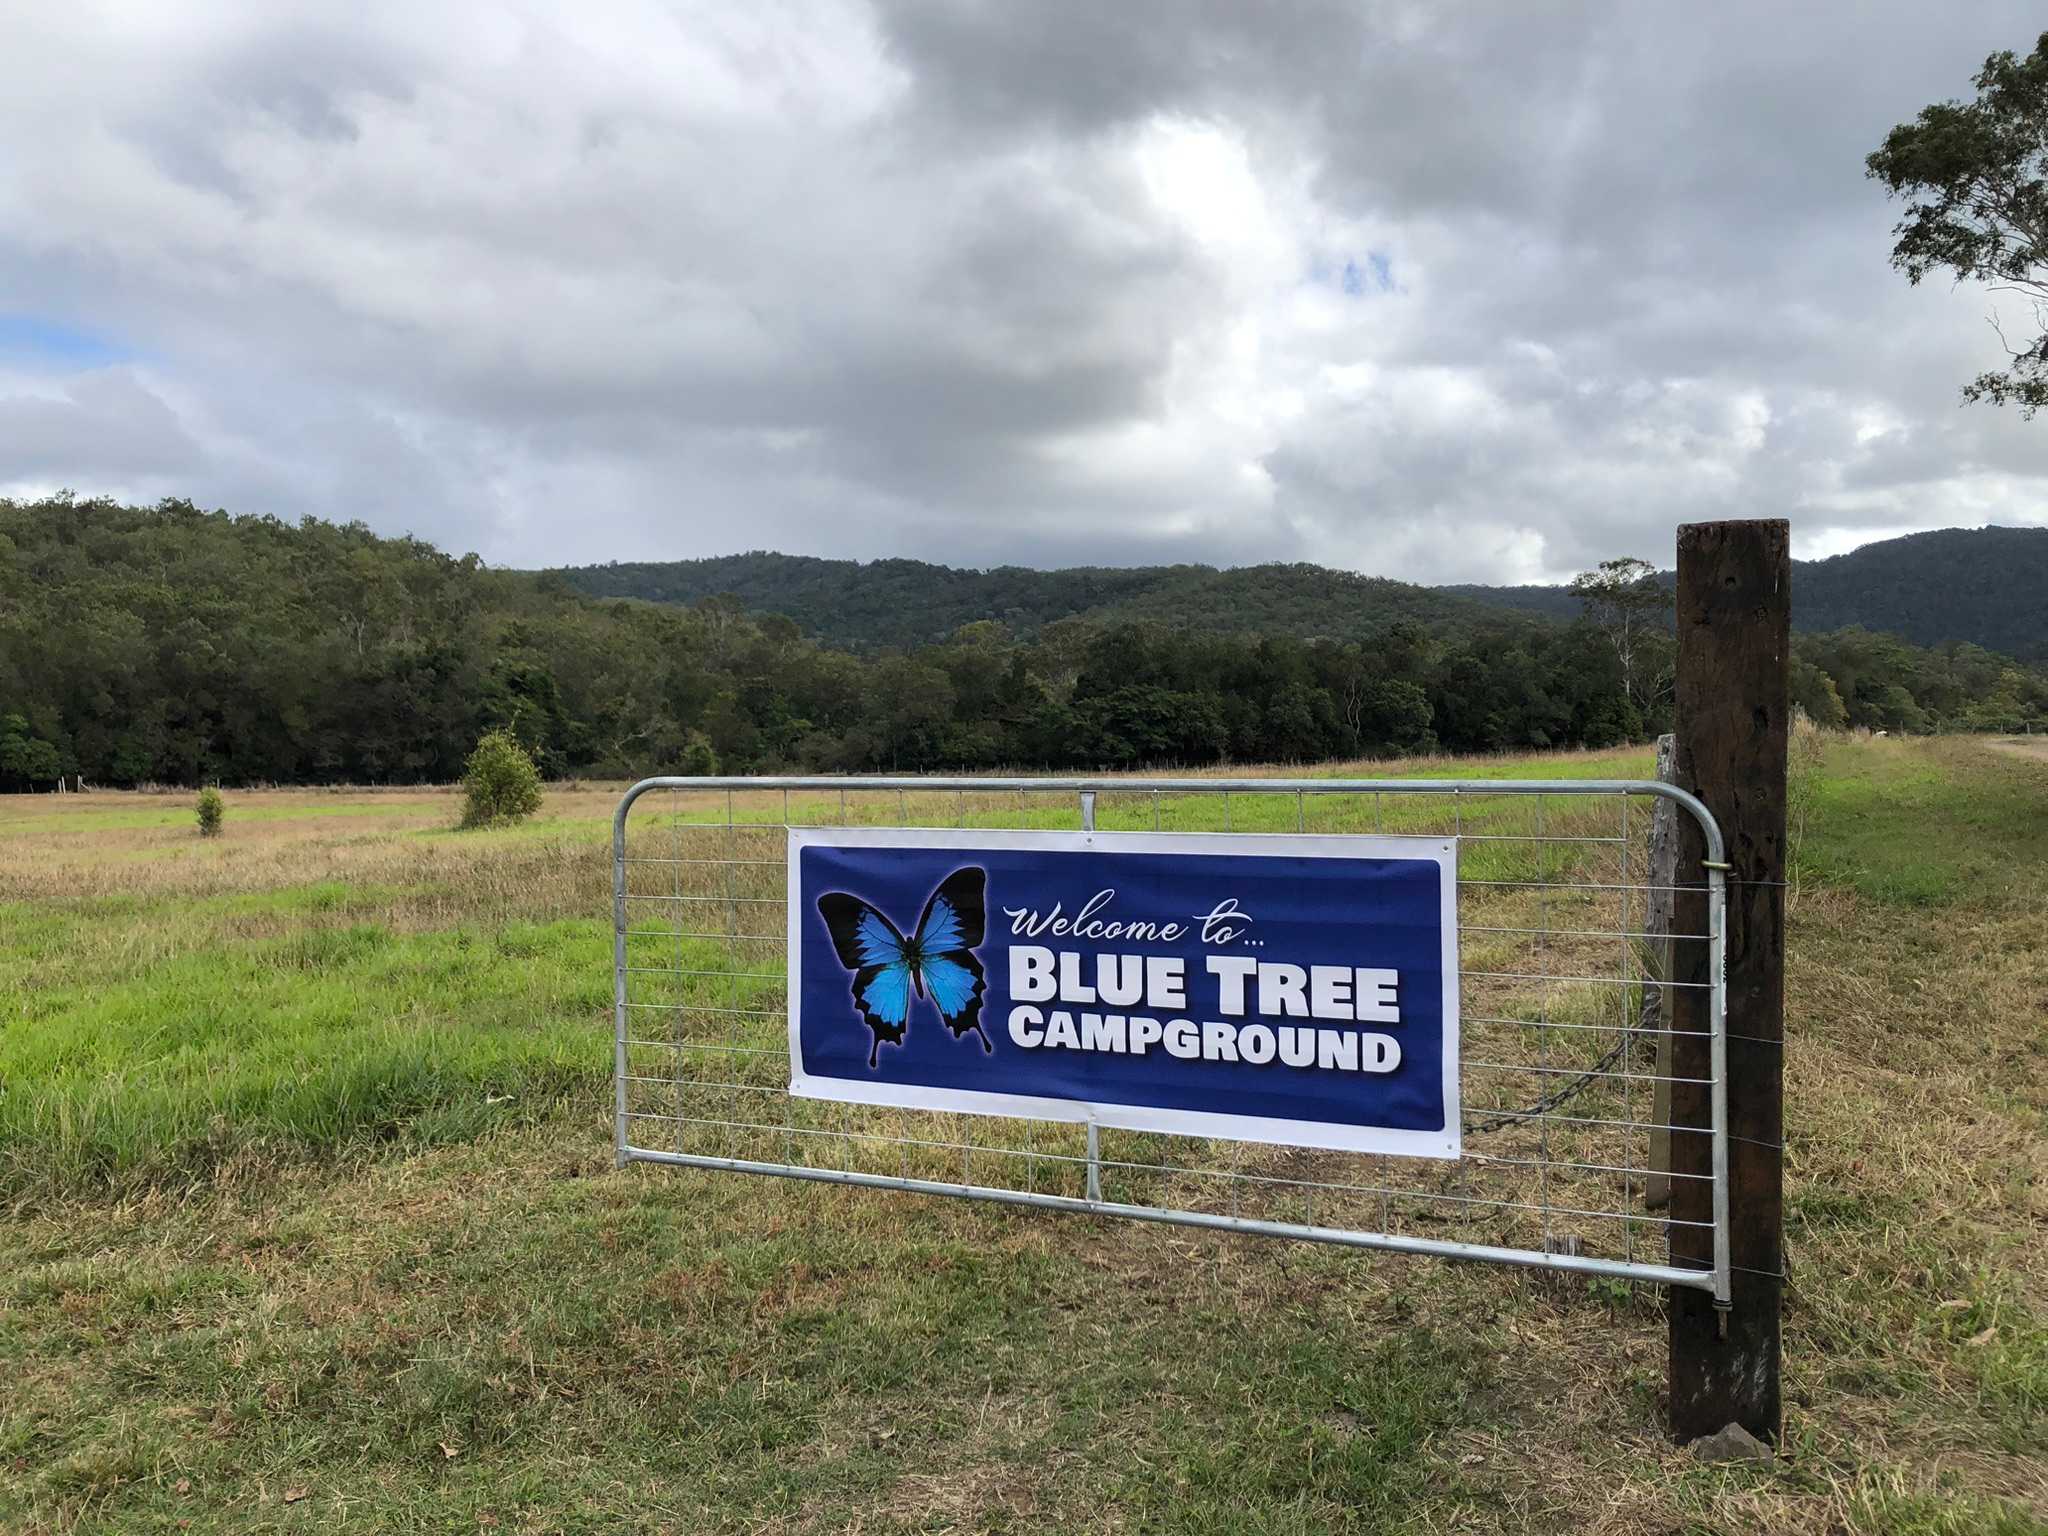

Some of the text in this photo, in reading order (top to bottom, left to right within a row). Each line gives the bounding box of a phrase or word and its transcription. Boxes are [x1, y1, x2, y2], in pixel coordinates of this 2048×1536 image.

[1002, 888, 1188, 942] Welcome
[1009, 945, 1400, 1023] BLUE TREE
[1008, 1005, 1401, 1073] CAMPGROUND
